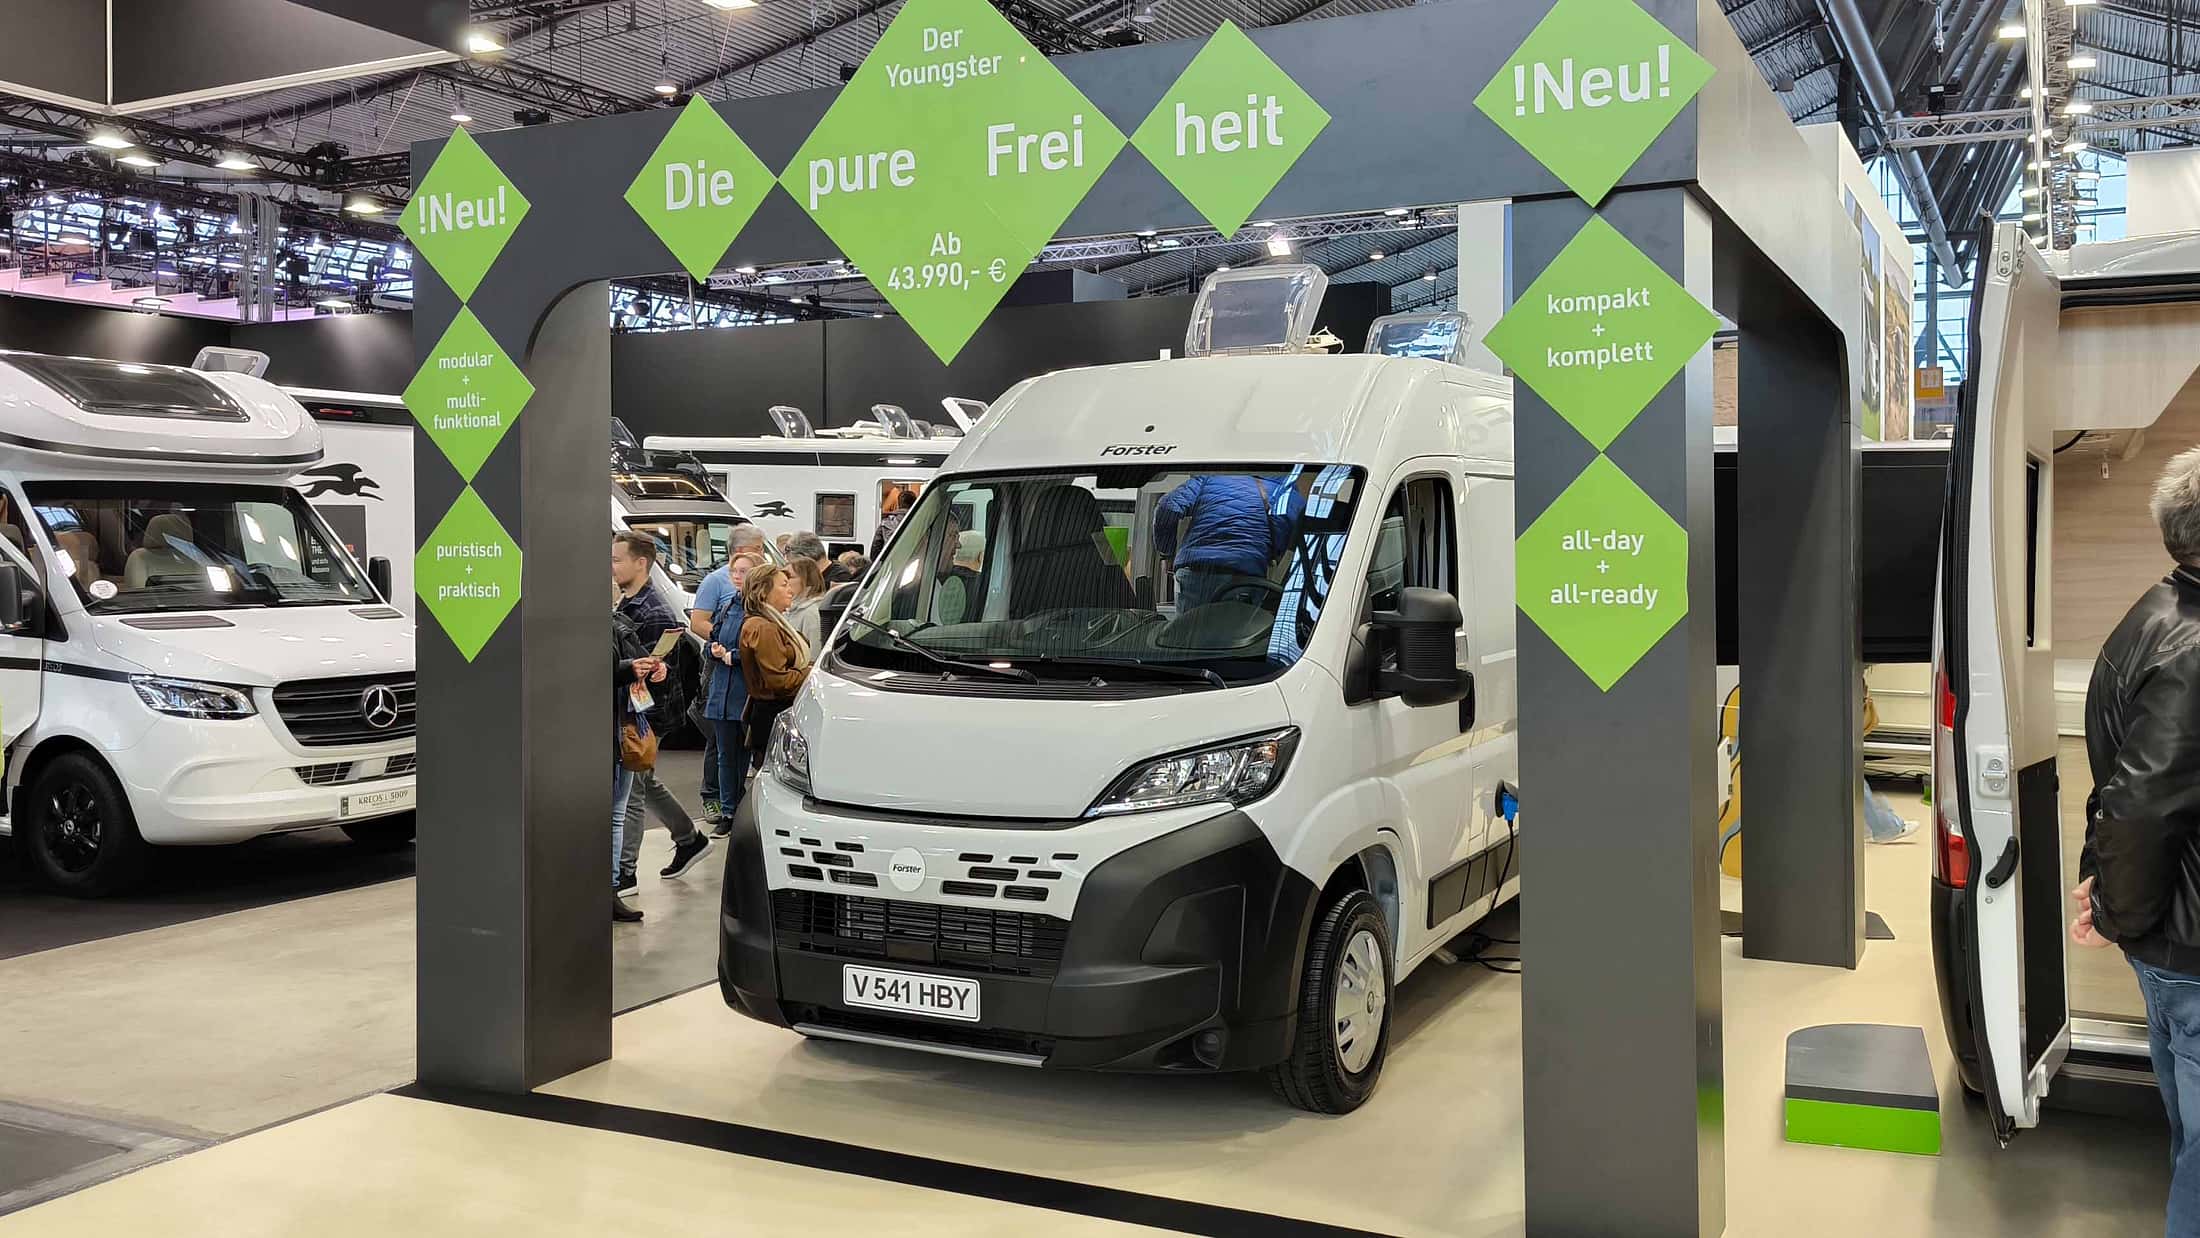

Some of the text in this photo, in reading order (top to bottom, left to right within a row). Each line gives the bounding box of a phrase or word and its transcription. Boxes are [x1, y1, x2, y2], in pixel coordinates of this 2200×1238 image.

[922, 27, 964, 53] Der
[885, 53, 1003, 88] Youngster
[1513, 44, 1671, 118] !Neu!
[1174, 93, 1285, 158] heit
[664, 113, 1084, 211] Die pure Frei
[417, 185, 507, 236] !Neu!
[930, 231, 961, 257] Ab
[887, 257, 1007, 292] 43.990,- €
[1547, 287, 1651, 317] kompakt
[438, 351, 494, 370] modular
[1547, 341, 1654, 371] komplett
[446, 392, 487, 409] multi-
[433, 410, 502, 431] funktional
[1100, 444, 1177, 456] Forster
[436, 542, 502, 561] puristisch
[1562, 529, 1645, 556] all-day
[438, 582, 501, 601] praktisch
[1550, 583, 1658, 610] all-ready
[892, 863, 921, 873] Forster
[852, 973, 970, 1011] V 541 HBY
